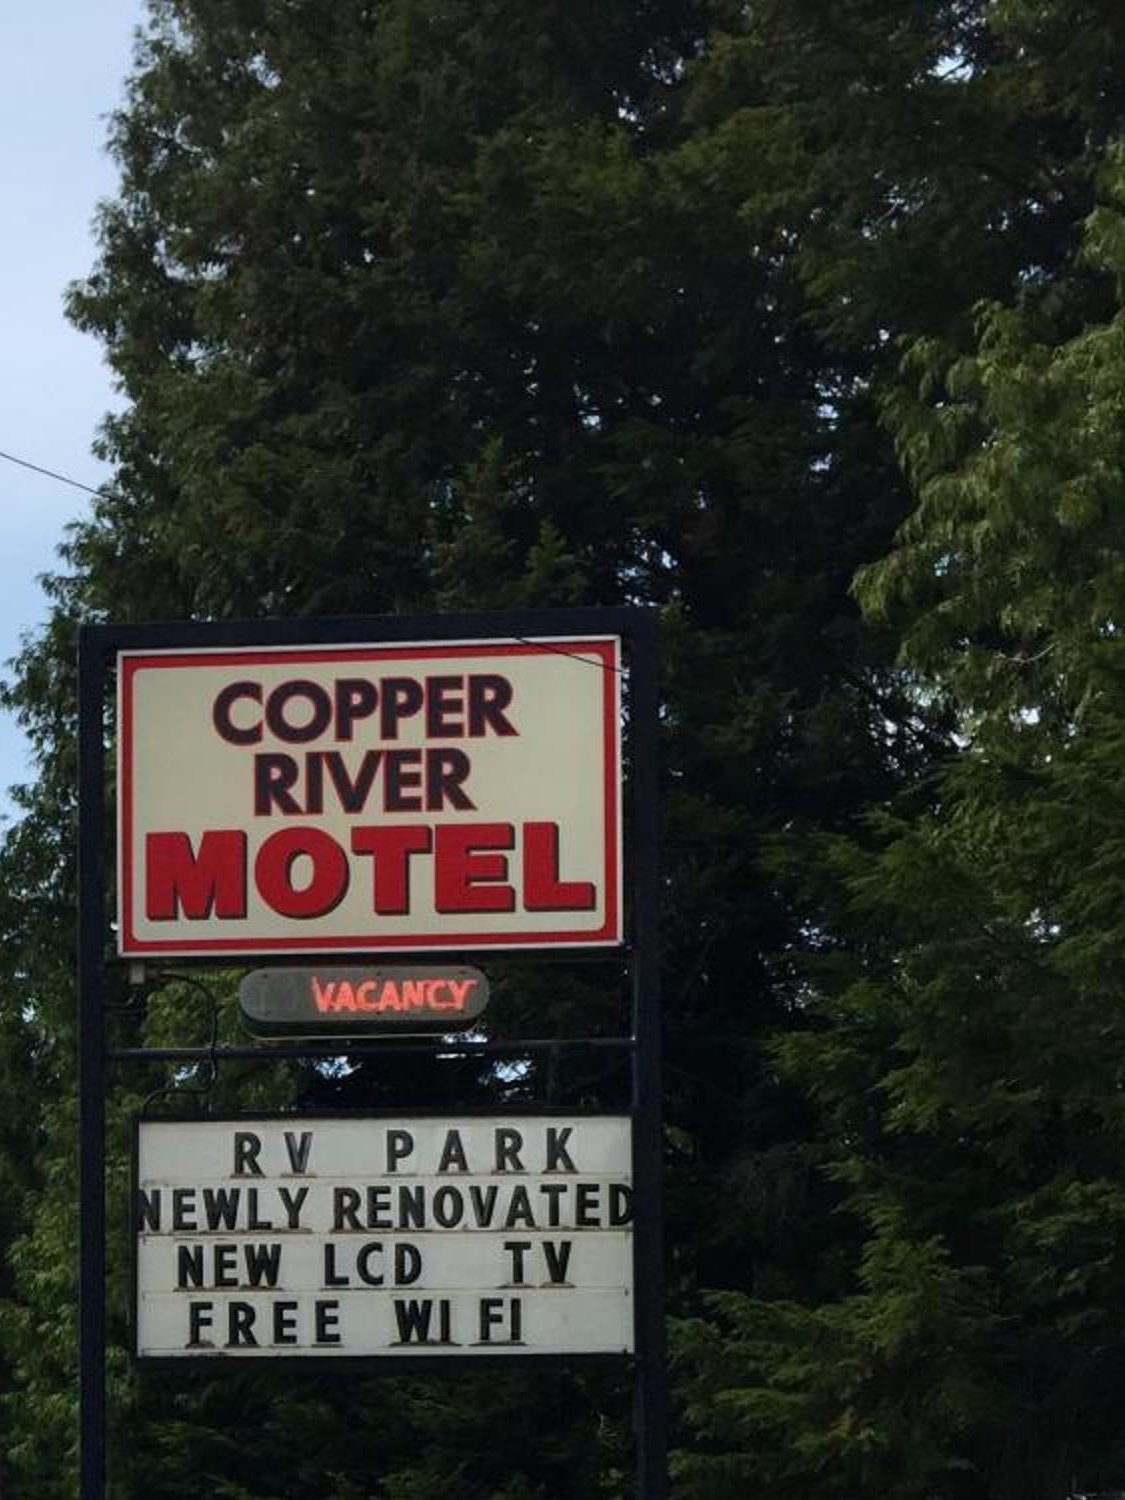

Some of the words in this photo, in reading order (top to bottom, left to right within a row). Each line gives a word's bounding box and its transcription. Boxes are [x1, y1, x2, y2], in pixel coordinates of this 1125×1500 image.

[213, 674, 519, 746] COPPER
[255, 747, 478, 816] RIVER
[145, 822, 596, 921] MOTEL
[311, 977, 476, 1013] VACANCY
[234, 1131, 313, 1174] RV
[386, 1128, 575, 1173] PARK
[138, 1187, 309, 1231] NEWLY
[333, 1184, 633, 1229] RENOVATED
[178, 1243, 282, 1288] NEW
[324, 1243, 422, 1285] LCD
[504, 1241, 572, 1285] TV
[189, 1301, 341, 1345] FREE
